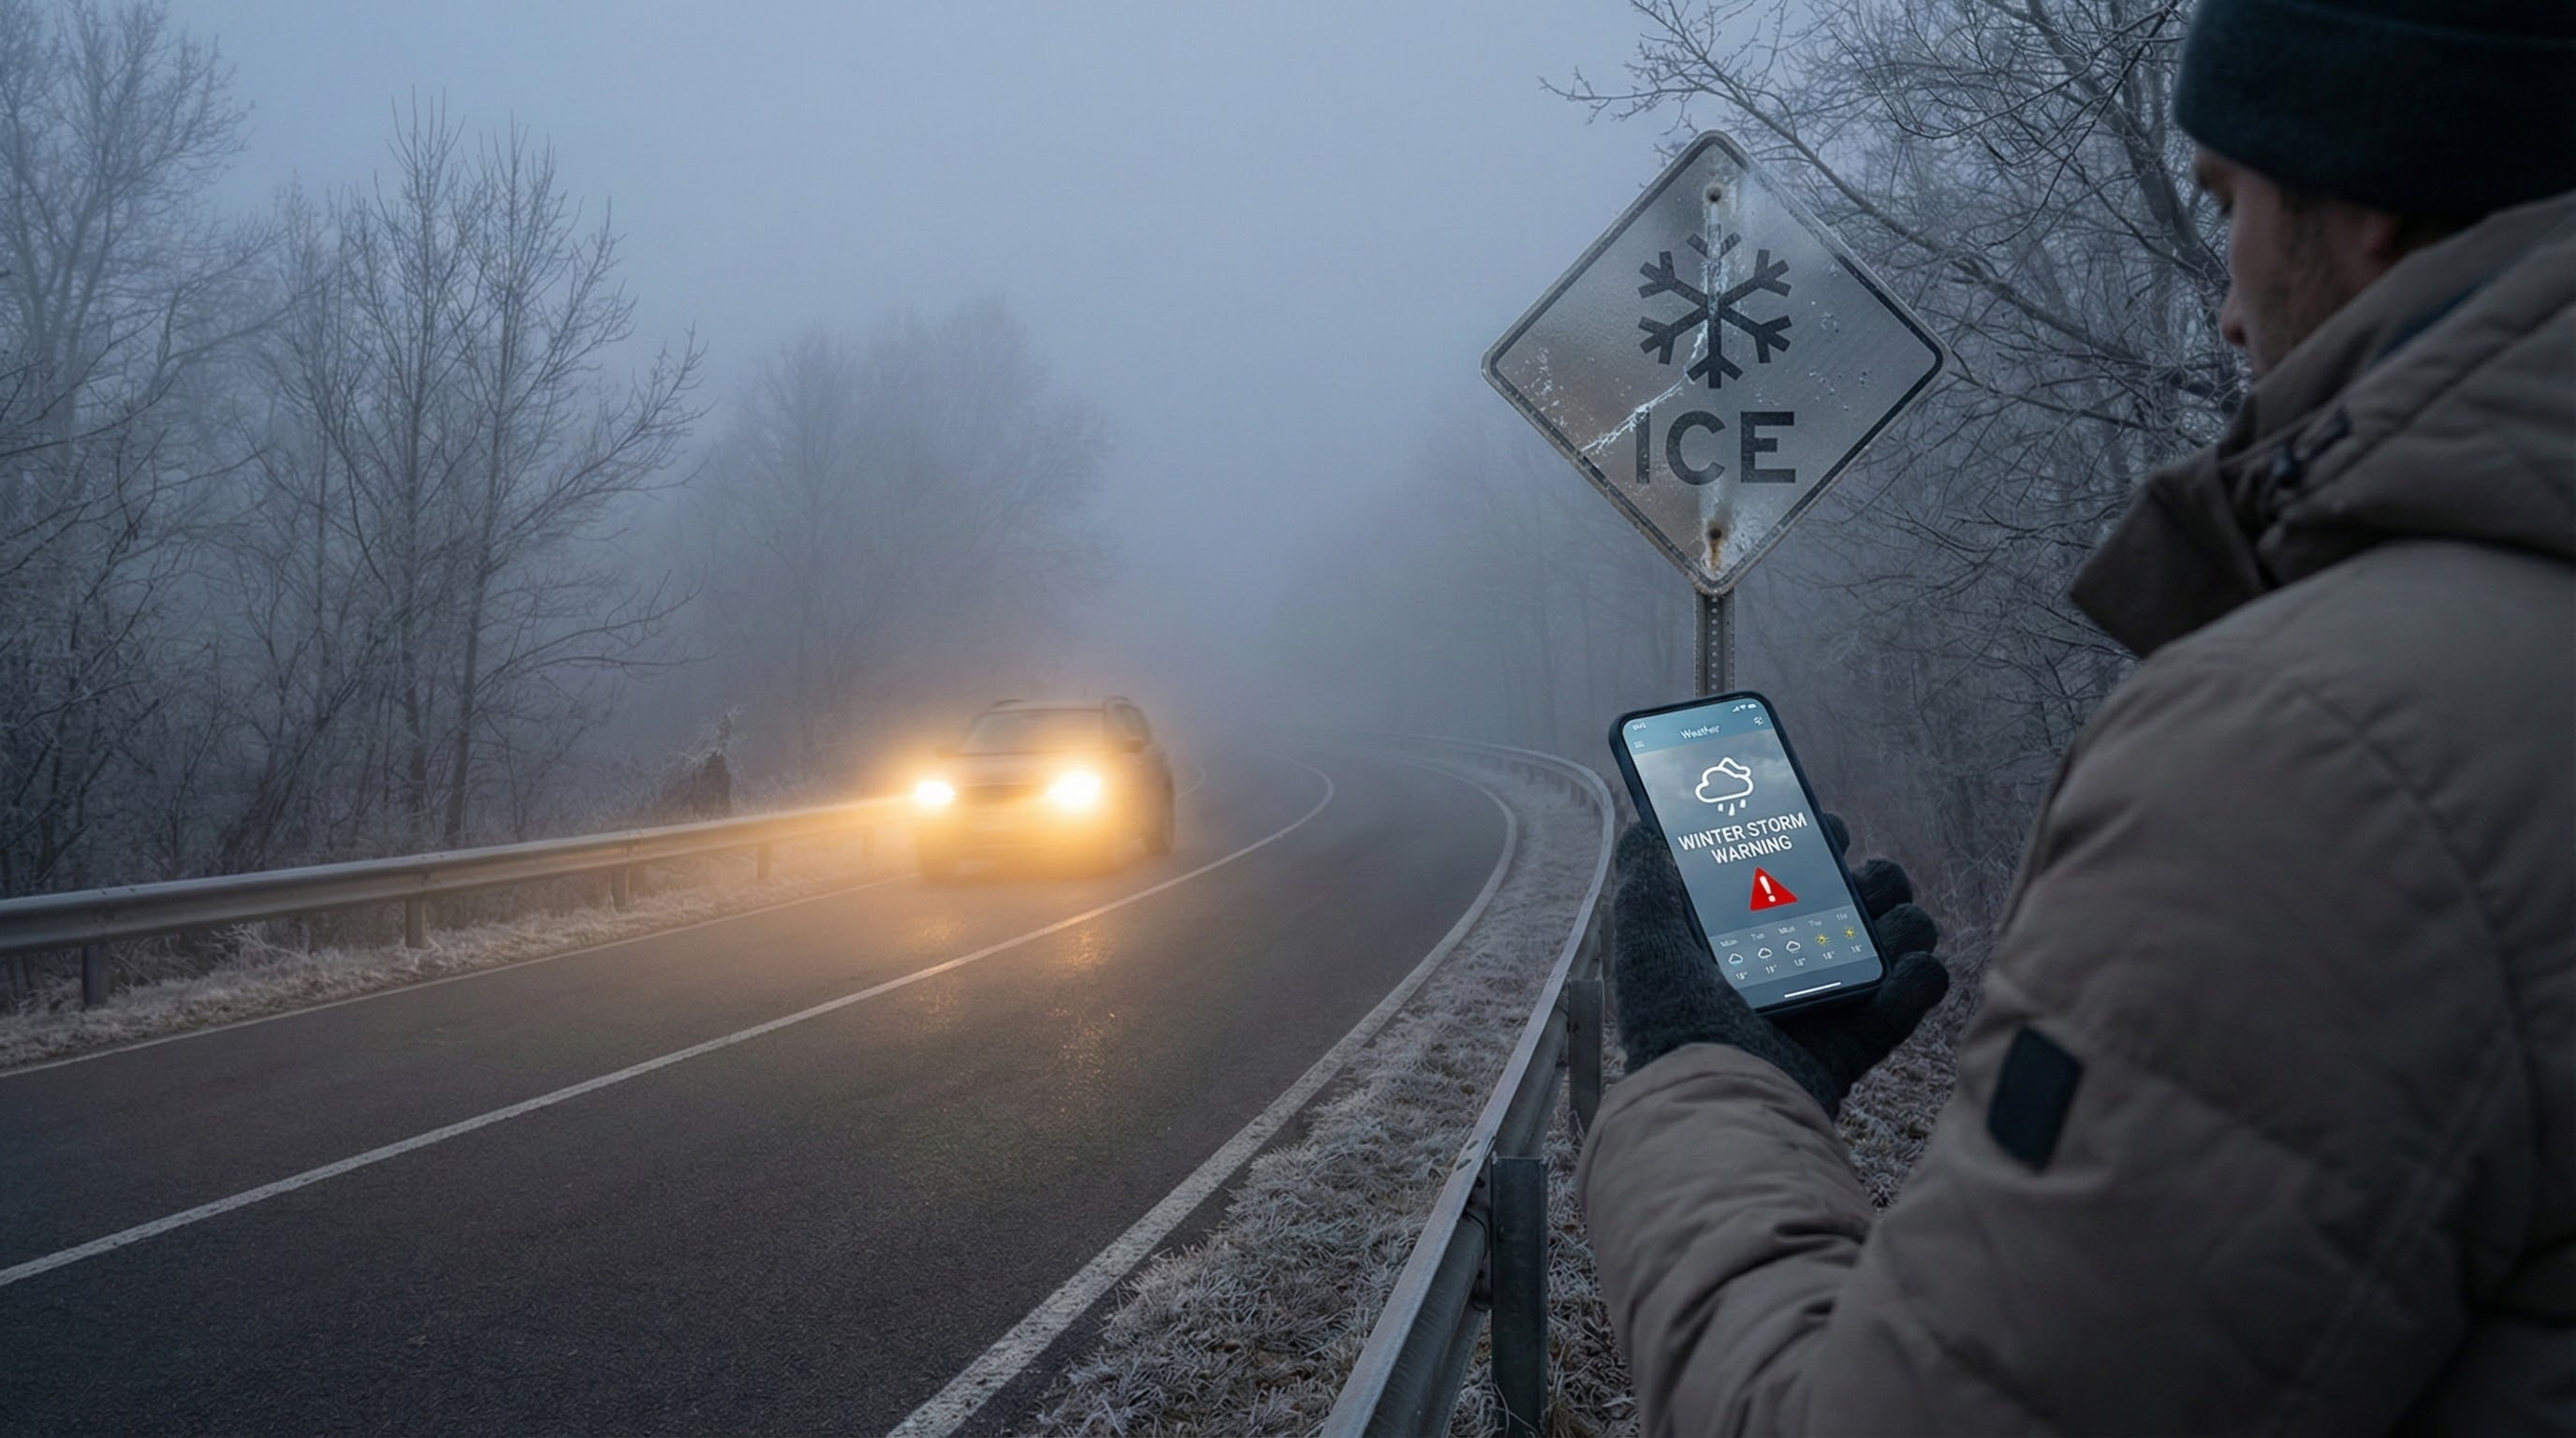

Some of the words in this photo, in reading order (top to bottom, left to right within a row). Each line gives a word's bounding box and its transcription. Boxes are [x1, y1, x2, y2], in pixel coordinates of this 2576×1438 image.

[1636, 410, 1796, 486] ICE
[1677, 825, 1747, 851] WINTER
[1747, 812, 1808, 837] STORM
[1711, 835, 1793, 864] WARNING
